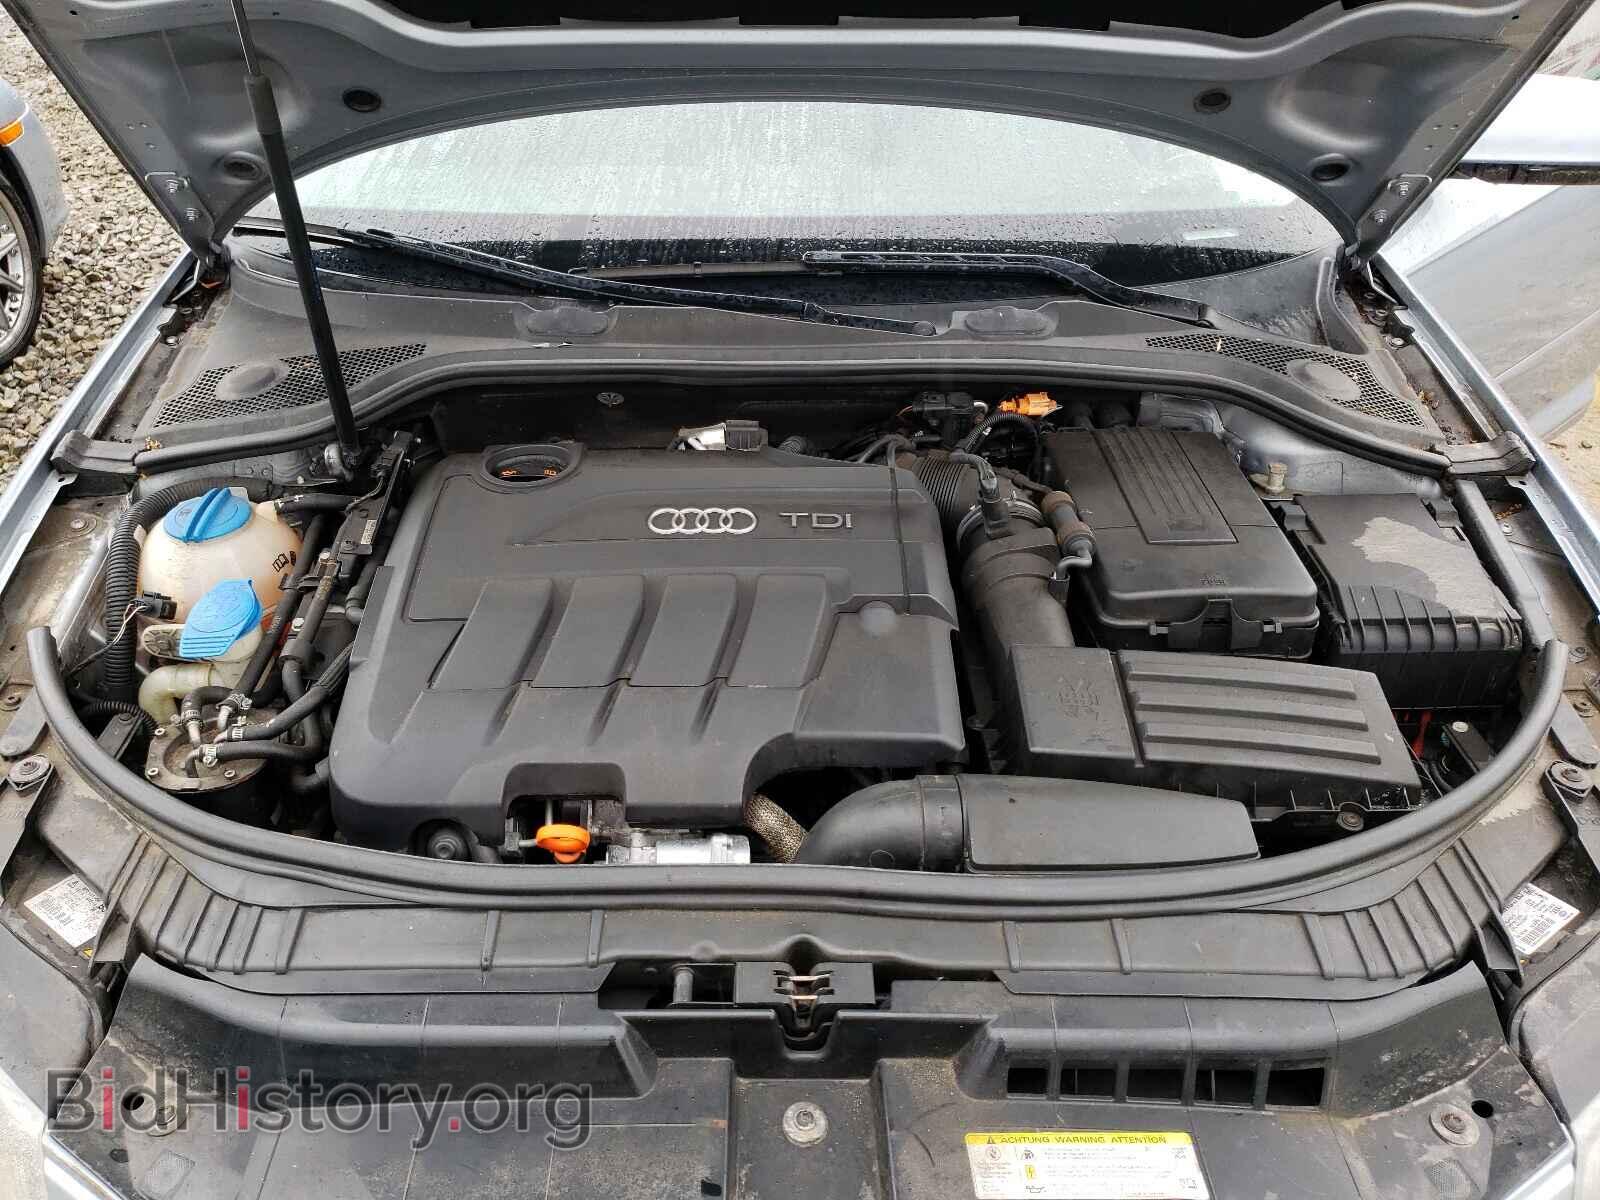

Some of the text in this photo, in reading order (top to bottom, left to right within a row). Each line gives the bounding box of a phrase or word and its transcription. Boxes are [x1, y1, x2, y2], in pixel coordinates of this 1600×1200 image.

[779, 511, 853, 529] TDI
[1000, 1136, 1167, 1144] ACHTUNG WARNING ATTENTION
